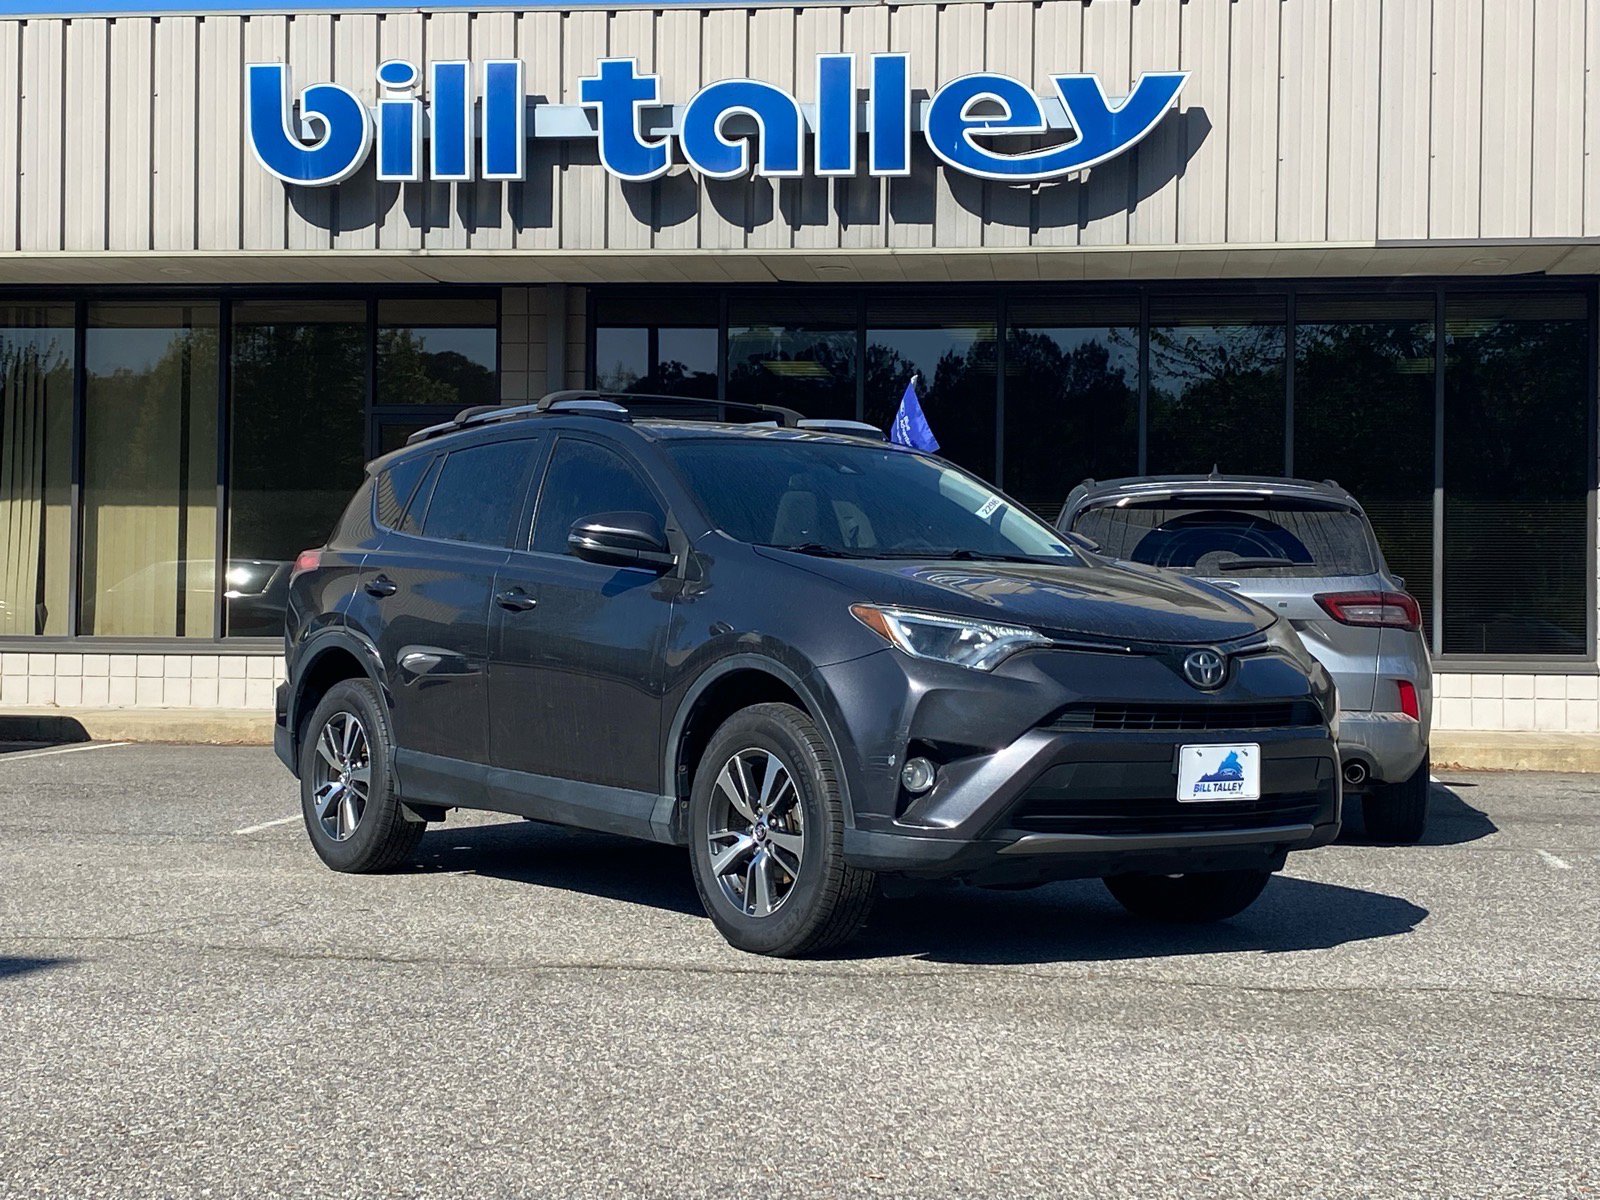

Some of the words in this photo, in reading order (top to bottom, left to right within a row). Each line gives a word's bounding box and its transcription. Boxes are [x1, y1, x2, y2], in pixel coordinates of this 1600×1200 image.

[245, 58, 527, 188] bill
[578, 51, 1193, 182] talley
[1193, 783, 1212, 793] BILL
[1213, 782, 1244, 792] TALLEY
